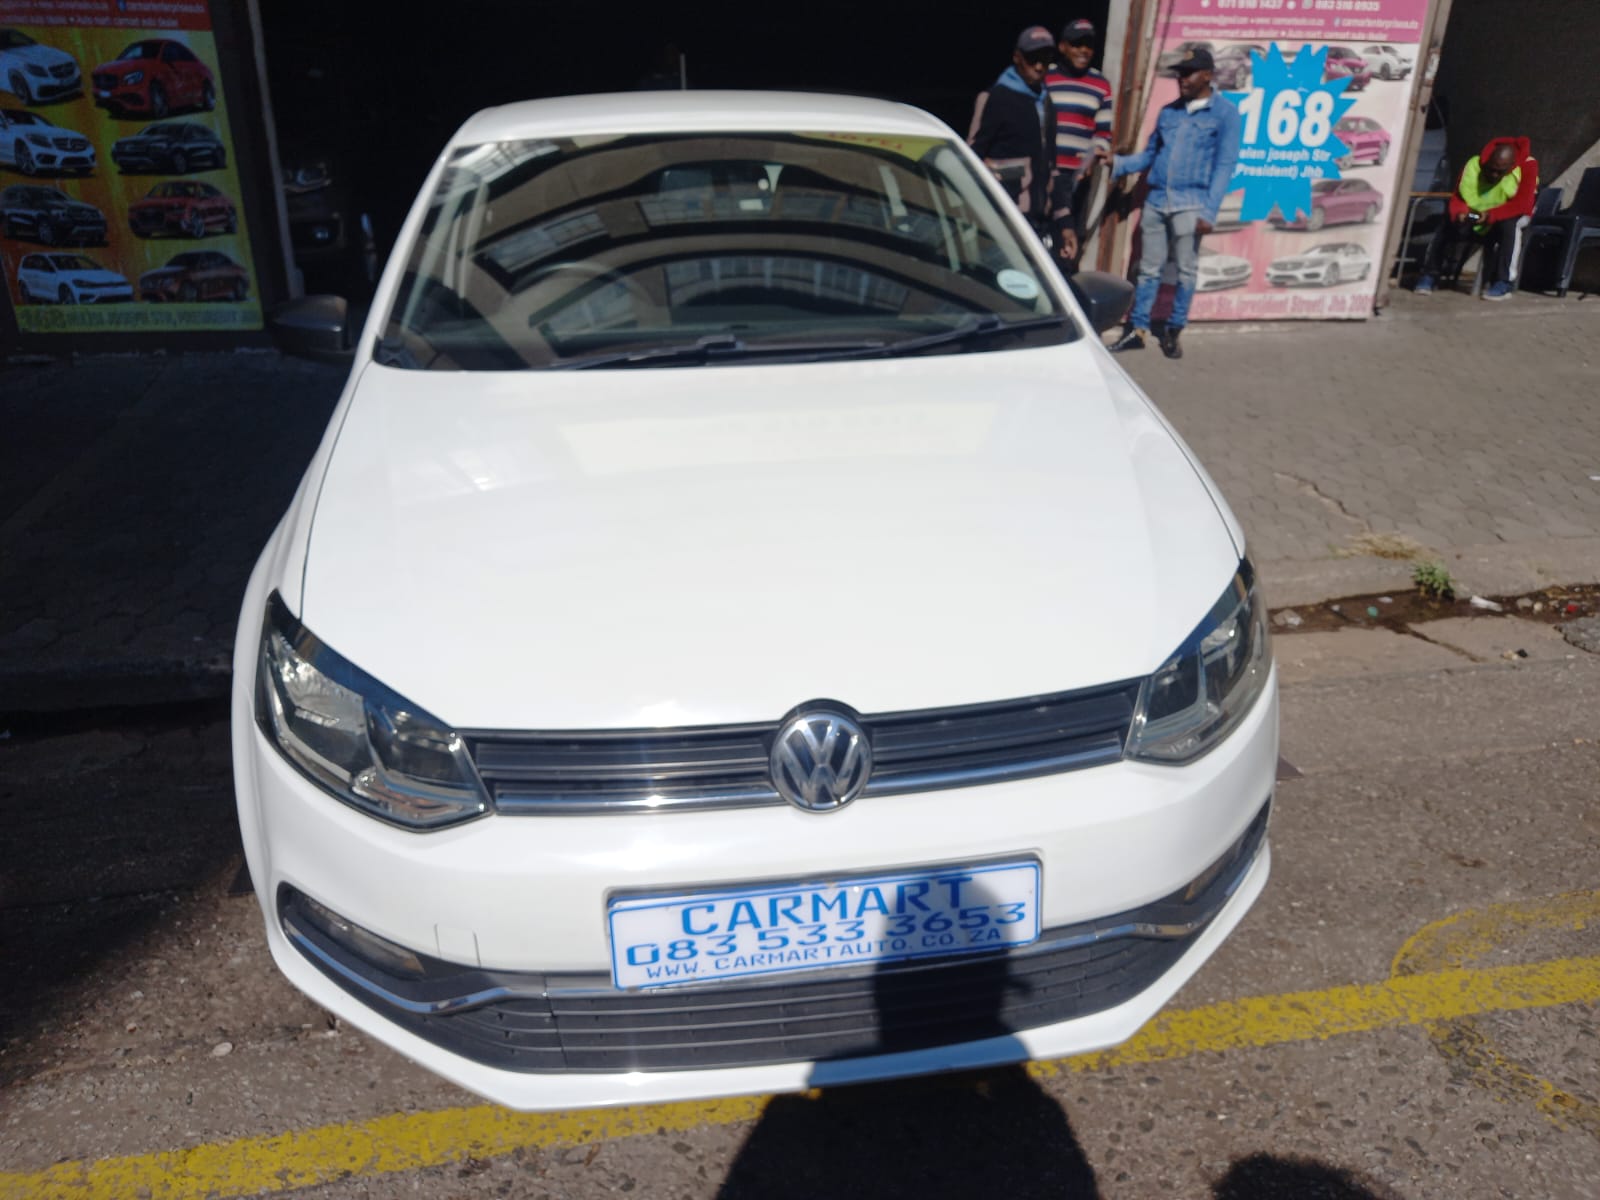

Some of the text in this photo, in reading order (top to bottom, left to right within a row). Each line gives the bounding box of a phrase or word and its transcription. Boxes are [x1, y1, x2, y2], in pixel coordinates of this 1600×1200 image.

[1238, 87, 1334, 147] 168
[626, 902, 1026, 967] 083 533 3653
[681, 876, 973, 936] CARMART
